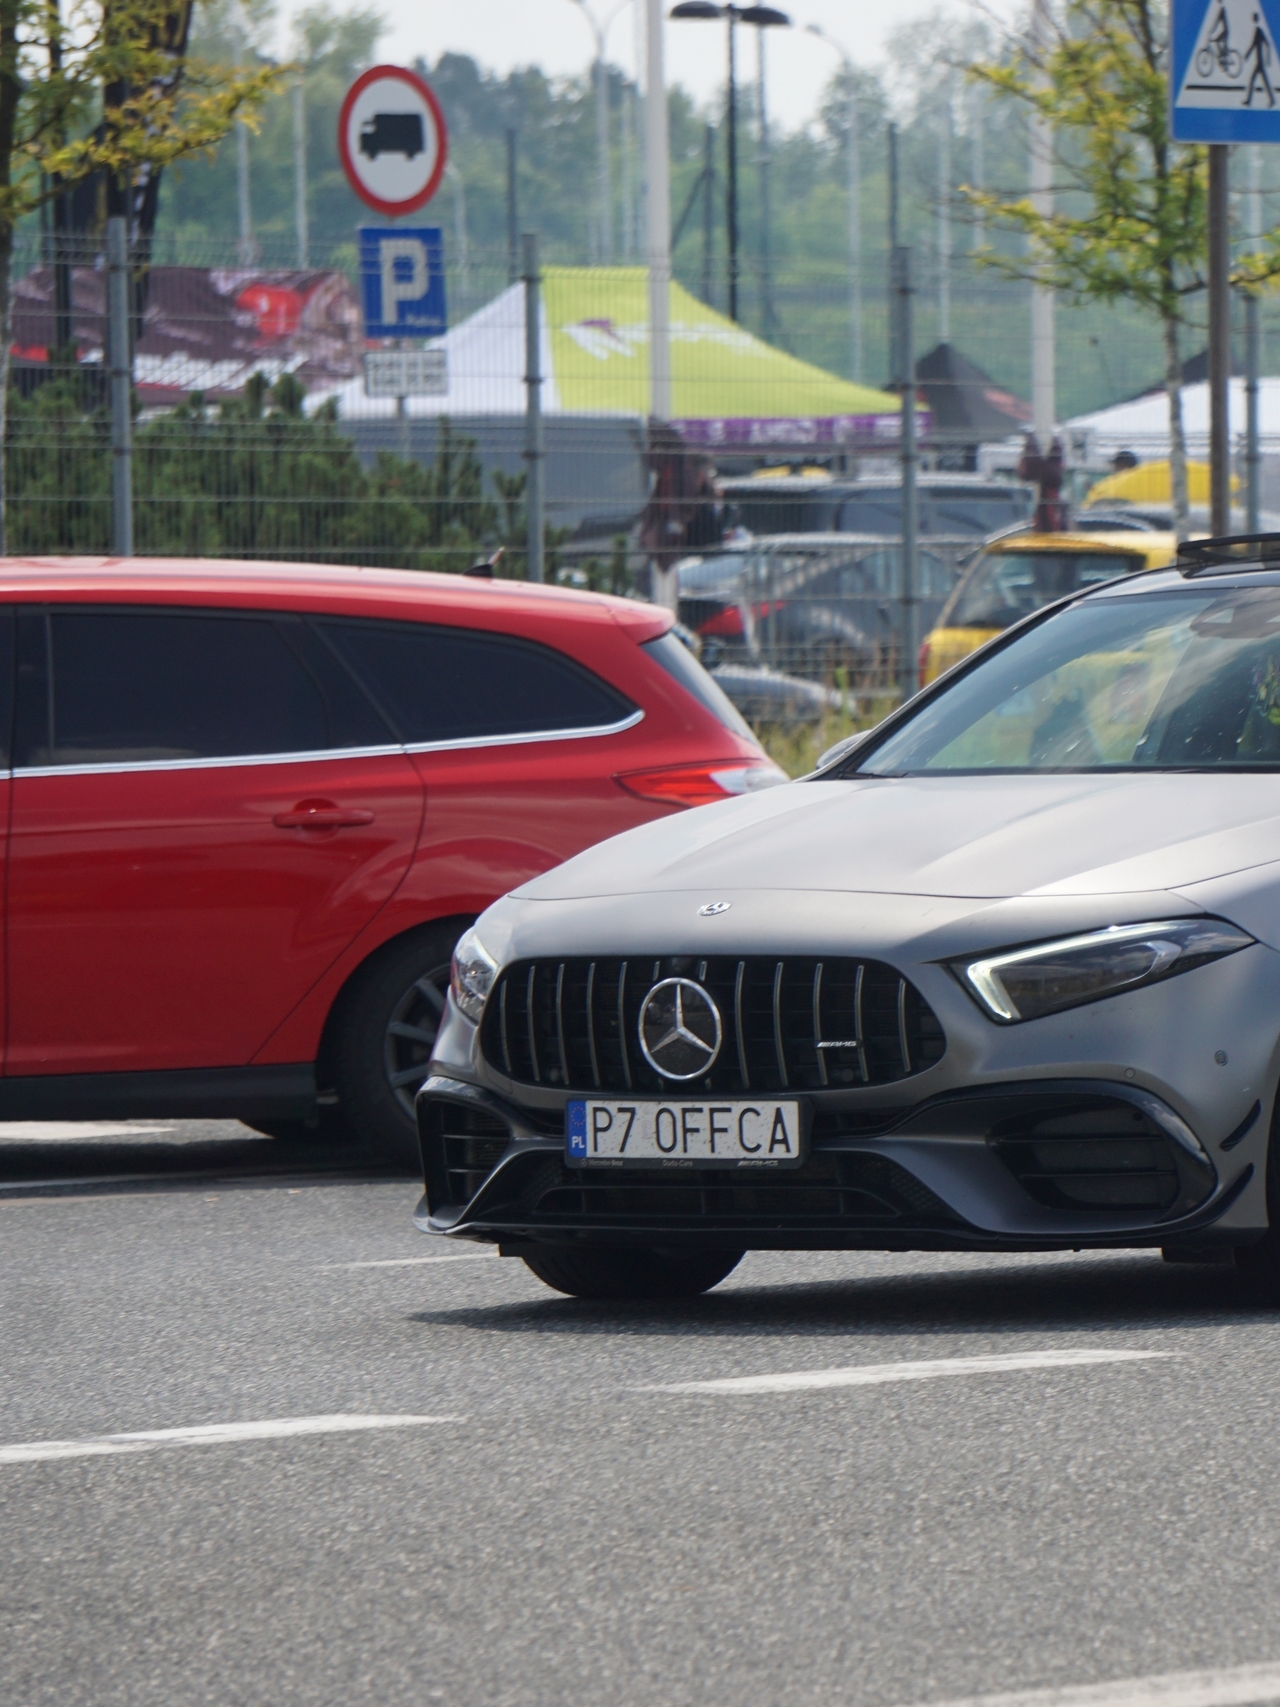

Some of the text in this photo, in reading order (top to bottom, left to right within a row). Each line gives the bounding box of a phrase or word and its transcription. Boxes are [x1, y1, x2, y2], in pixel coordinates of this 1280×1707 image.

[379, 238, 430, 326] P
[572, 1136, 585, 1149] PL
[592, 1107, 636, 1153] P7
